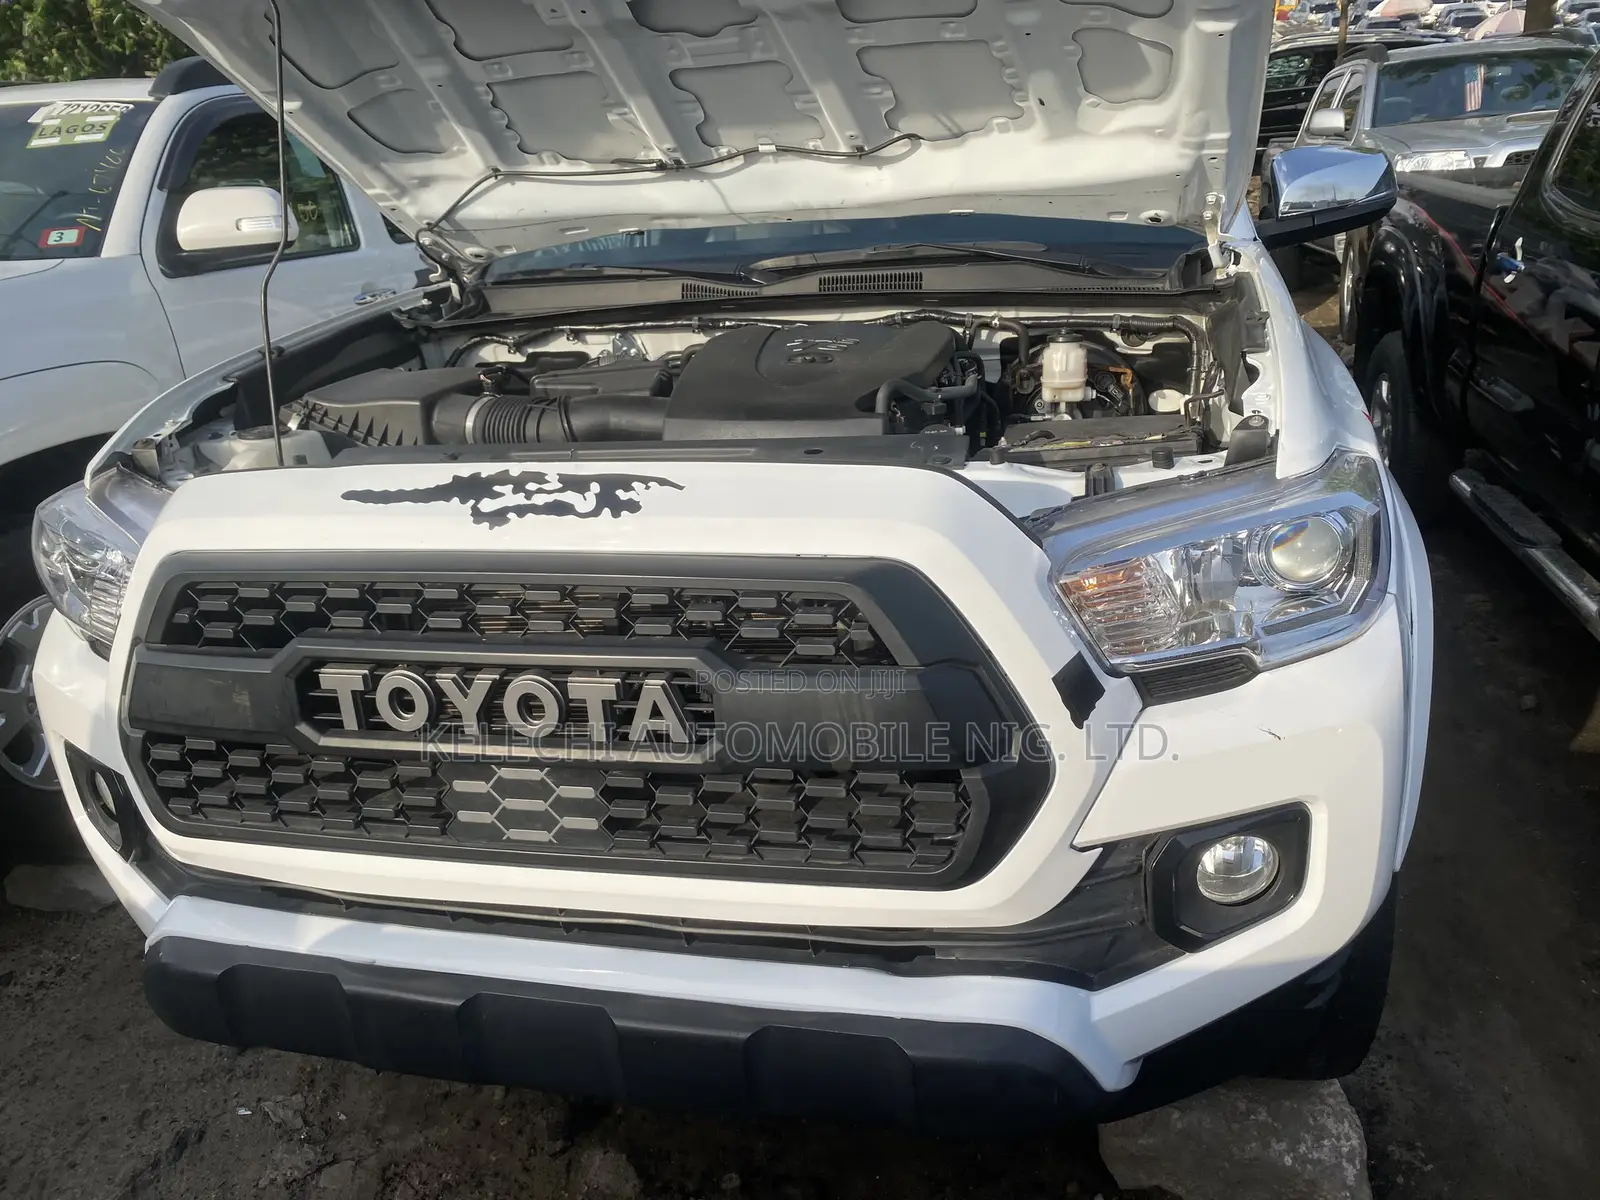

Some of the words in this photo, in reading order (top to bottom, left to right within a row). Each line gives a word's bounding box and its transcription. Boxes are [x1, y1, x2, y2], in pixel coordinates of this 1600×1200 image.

[39, 123, 108, 137] LAGOS
[54, 231, 64, 242] 3
[317, 664, 694, 743] TOYOTA
